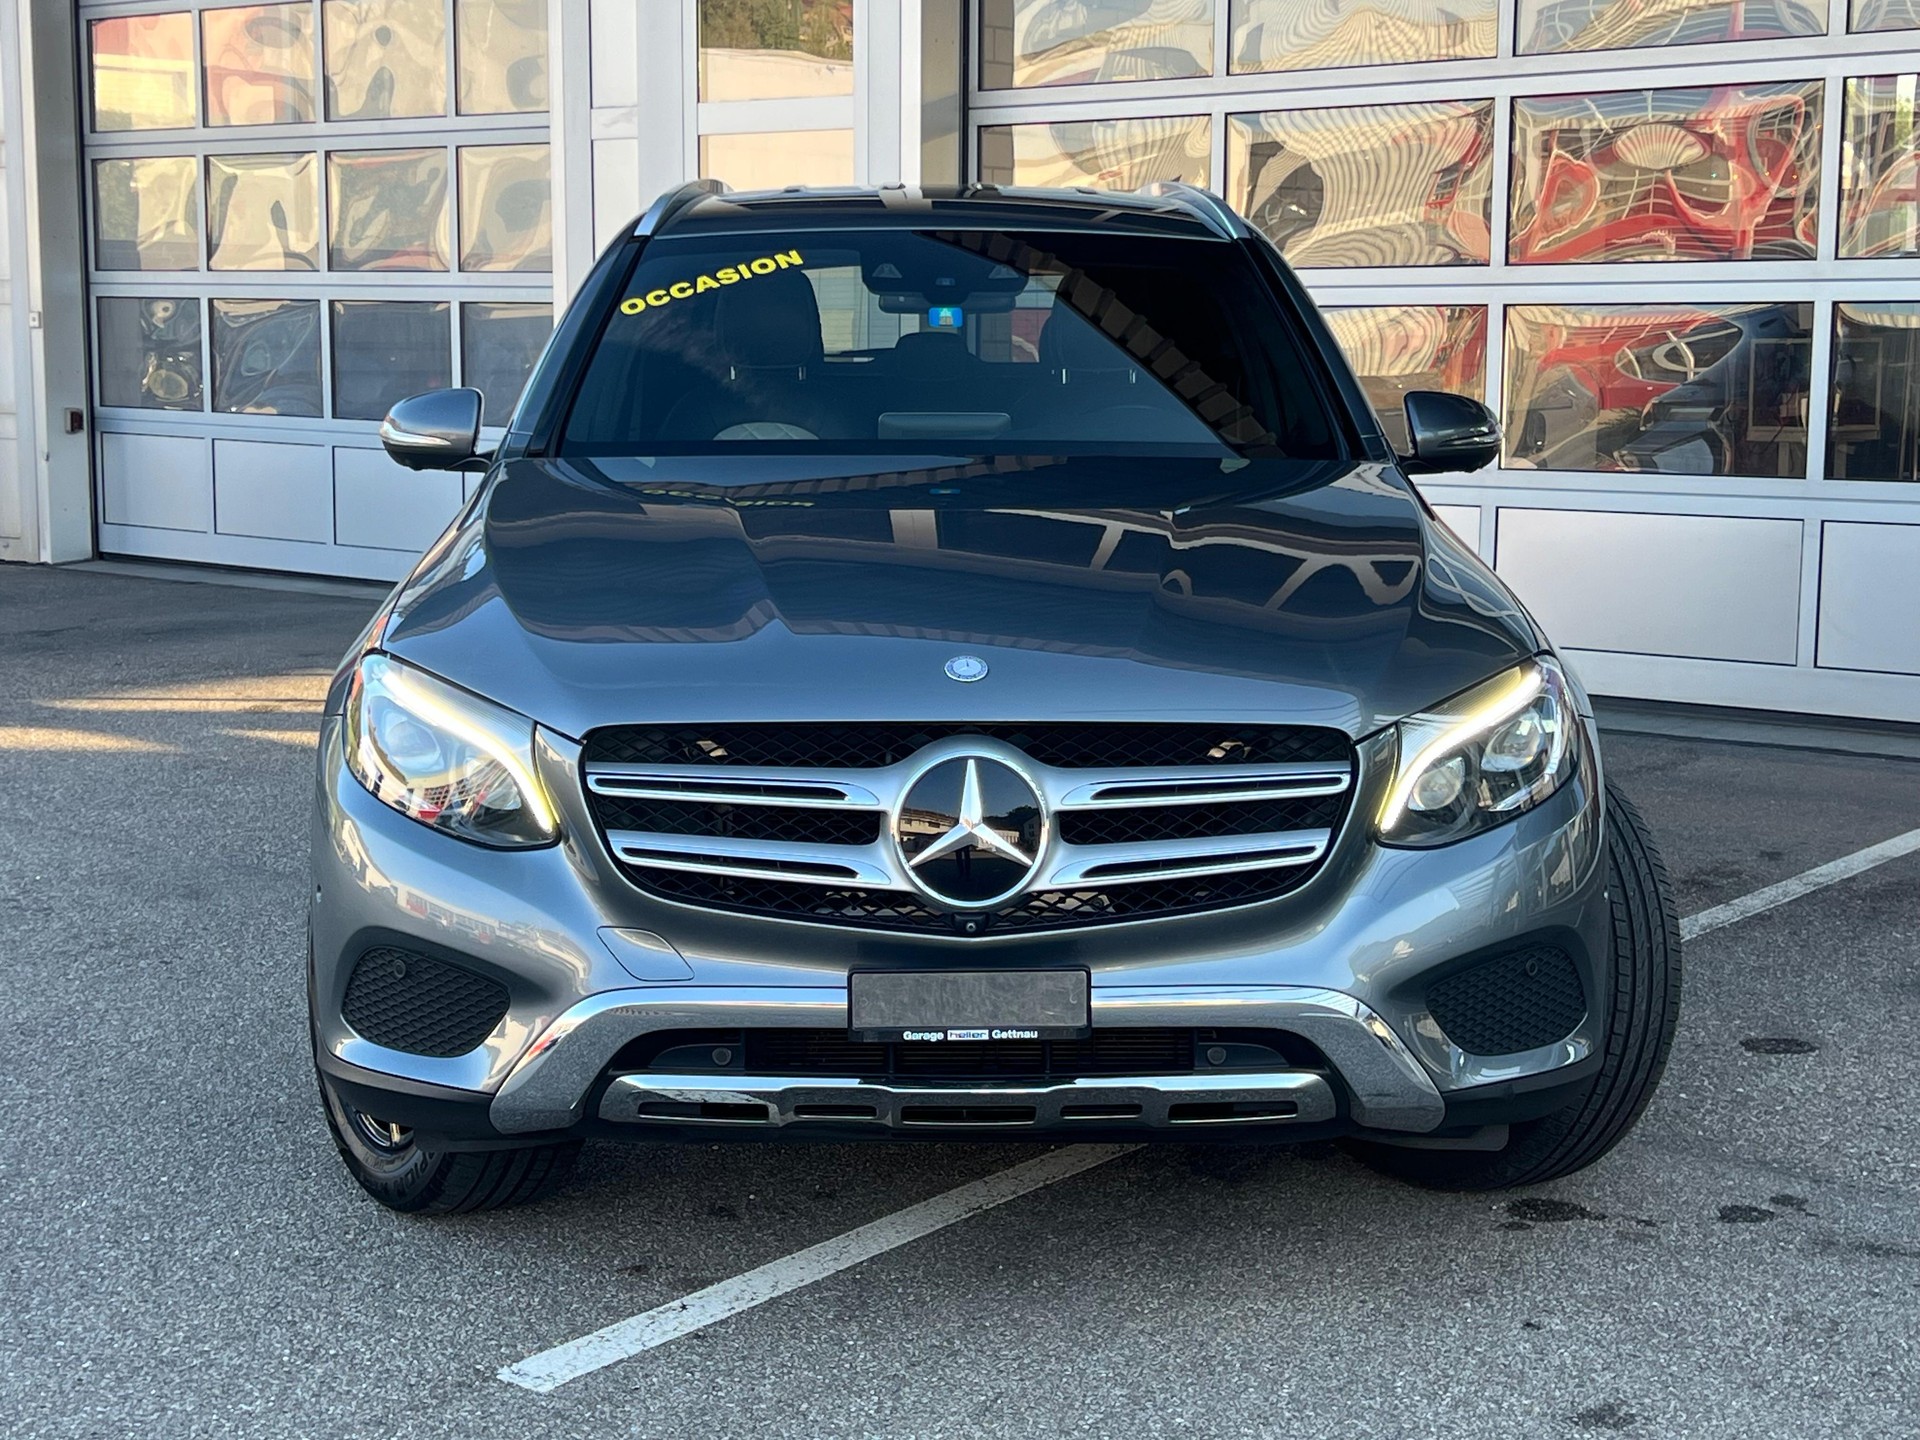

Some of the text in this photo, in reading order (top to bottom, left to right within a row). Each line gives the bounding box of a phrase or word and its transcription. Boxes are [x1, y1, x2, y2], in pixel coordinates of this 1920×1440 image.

[620, 249, 804, 315] OCCASION
[903, 1031, 944, 1041] Garage
[992, 1029, 1038, 1039] Gettnau
